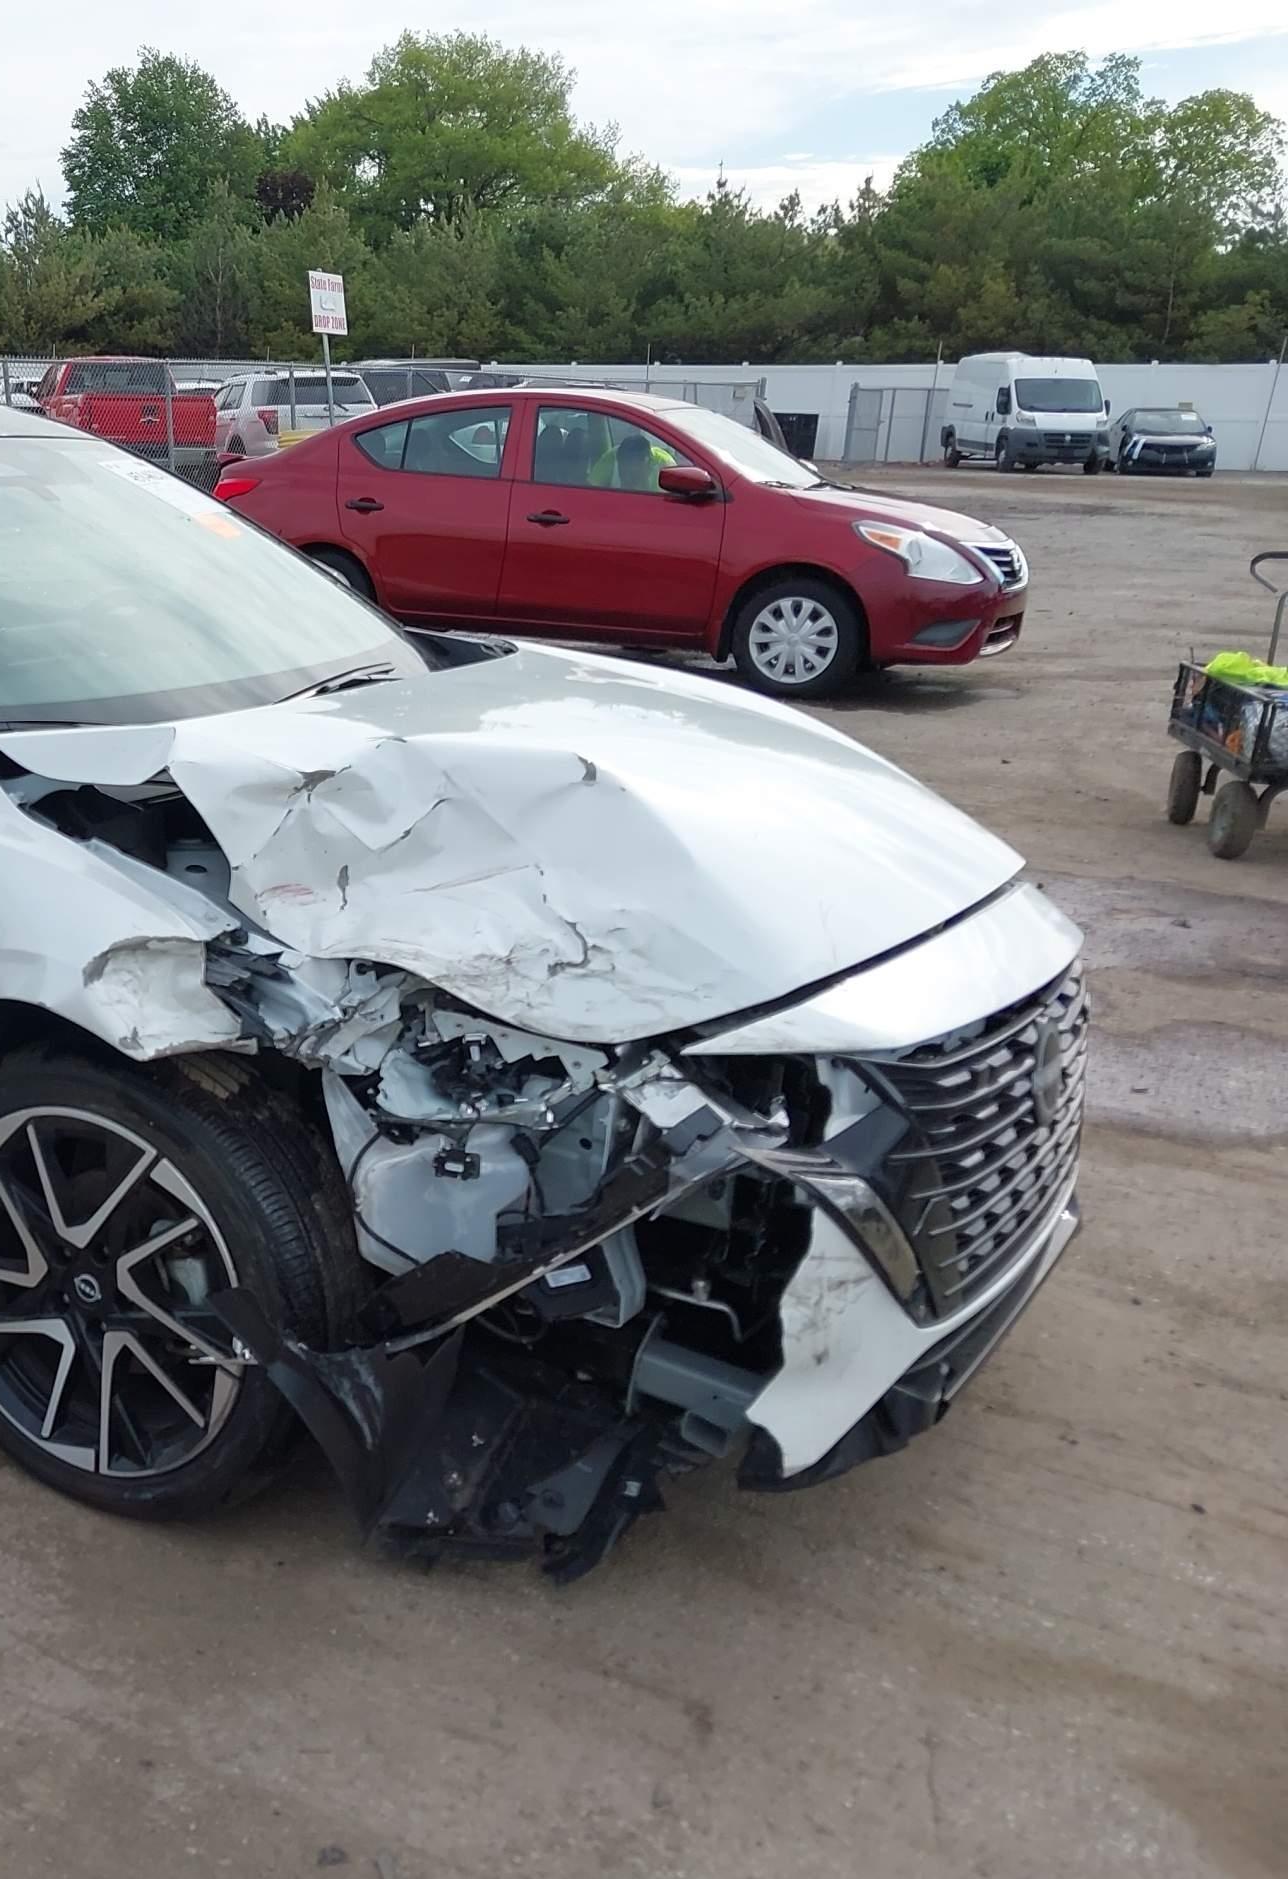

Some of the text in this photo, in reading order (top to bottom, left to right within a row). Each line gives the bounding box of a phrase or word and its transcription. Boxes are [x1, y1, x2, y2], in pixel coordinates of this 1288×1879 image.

[310, 276, 343, 293] State Farm
[314, 314, 346, 330] DROP ZONE
